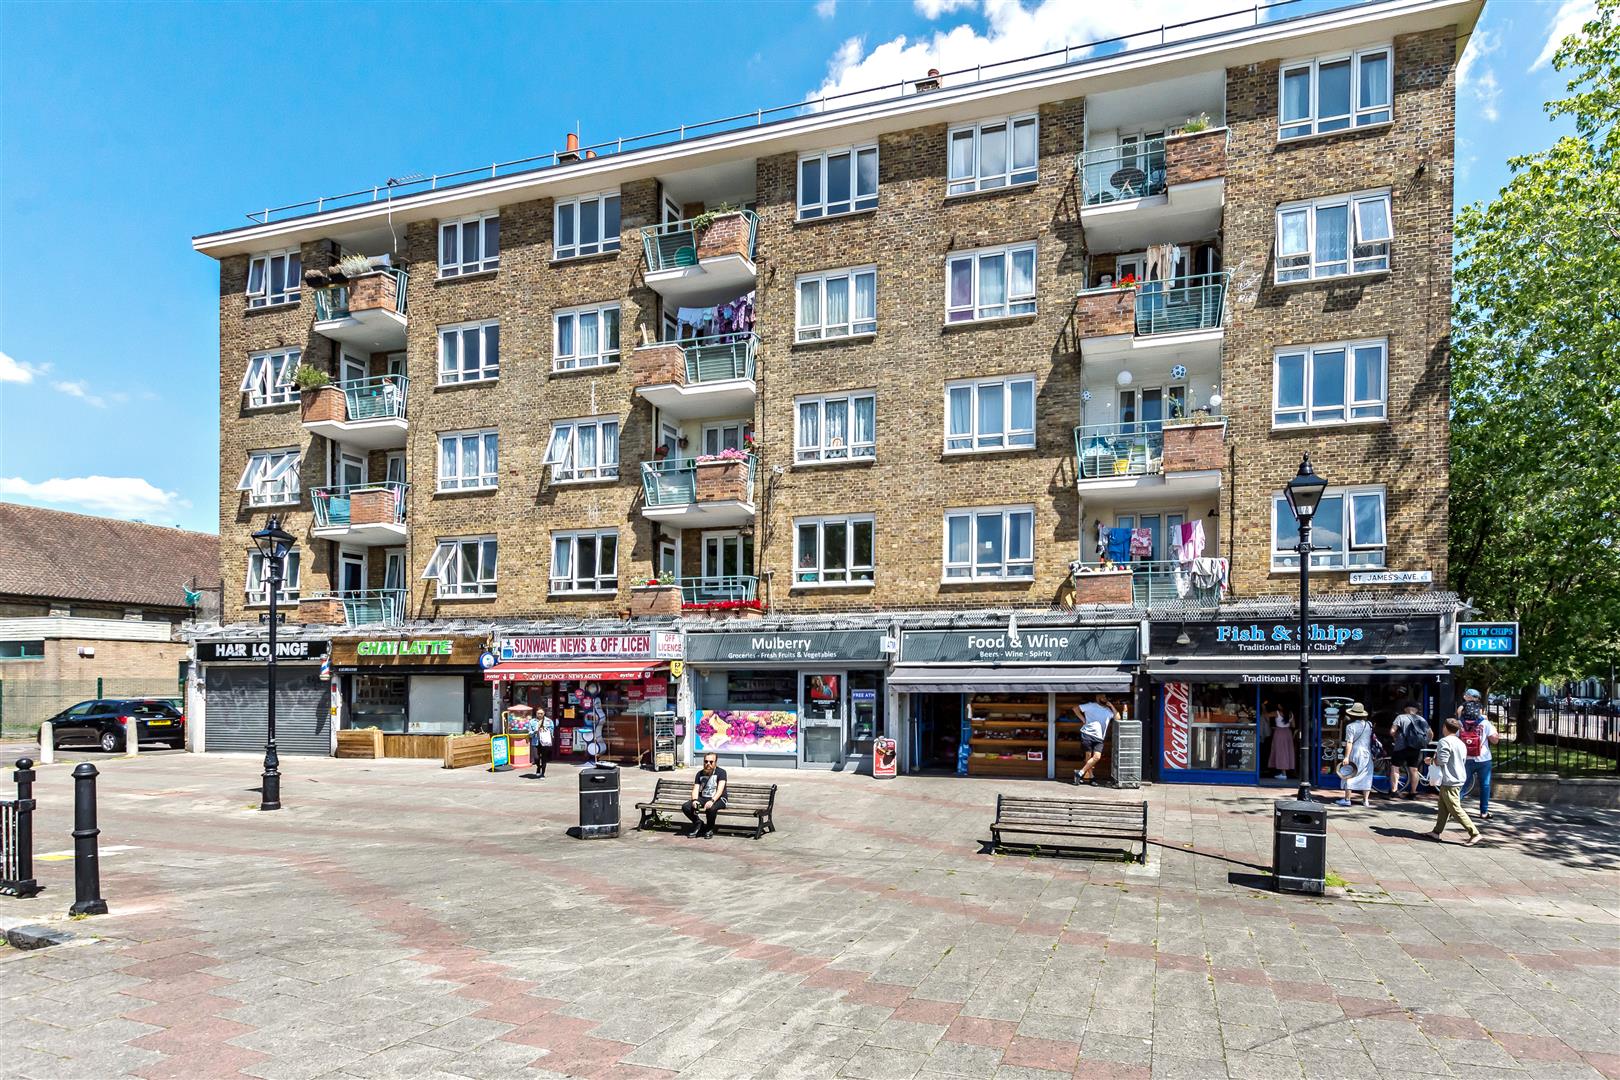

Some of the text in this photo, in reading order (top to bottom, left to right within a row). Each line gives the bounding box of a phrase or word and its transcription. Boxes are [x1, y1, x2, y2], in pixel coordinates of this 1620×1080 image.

[1216, 624, 1266, 642] Fish
[1271, 624, 1293, 641] &
[1461, 627, 1479, 636] FISH
[1490, 627, 1514, 636] CHIPS
[664, 634, 676, 642] OFF
[968, 634, 1069, 649] Food & Wine
[357, 639, 454, 656] CHAI LATTE
[514, 636, 650, 654] SUNWAVE NEWS & OFF LICEN
[658, 643, 682, 652] LICENCE
[751, 637, 812, 652] Mulberry
[1238, 643, 1282, 651] Traditional
[1314, 643, 1337, 652] Chips
[1465, 638, 1508, 649] OPEN
[215, 643, 247, 657] HAIR
[979, 650, 999, 658] Beers
[1004, 650, 1023, 658] Wine
[1029, 650, 1053, 658] Spirits
[803, 651, 837, 659] Vegetables
[1242, 674, 1289, 683] Traditional
[1321, 675, 1346, 683] Chips
